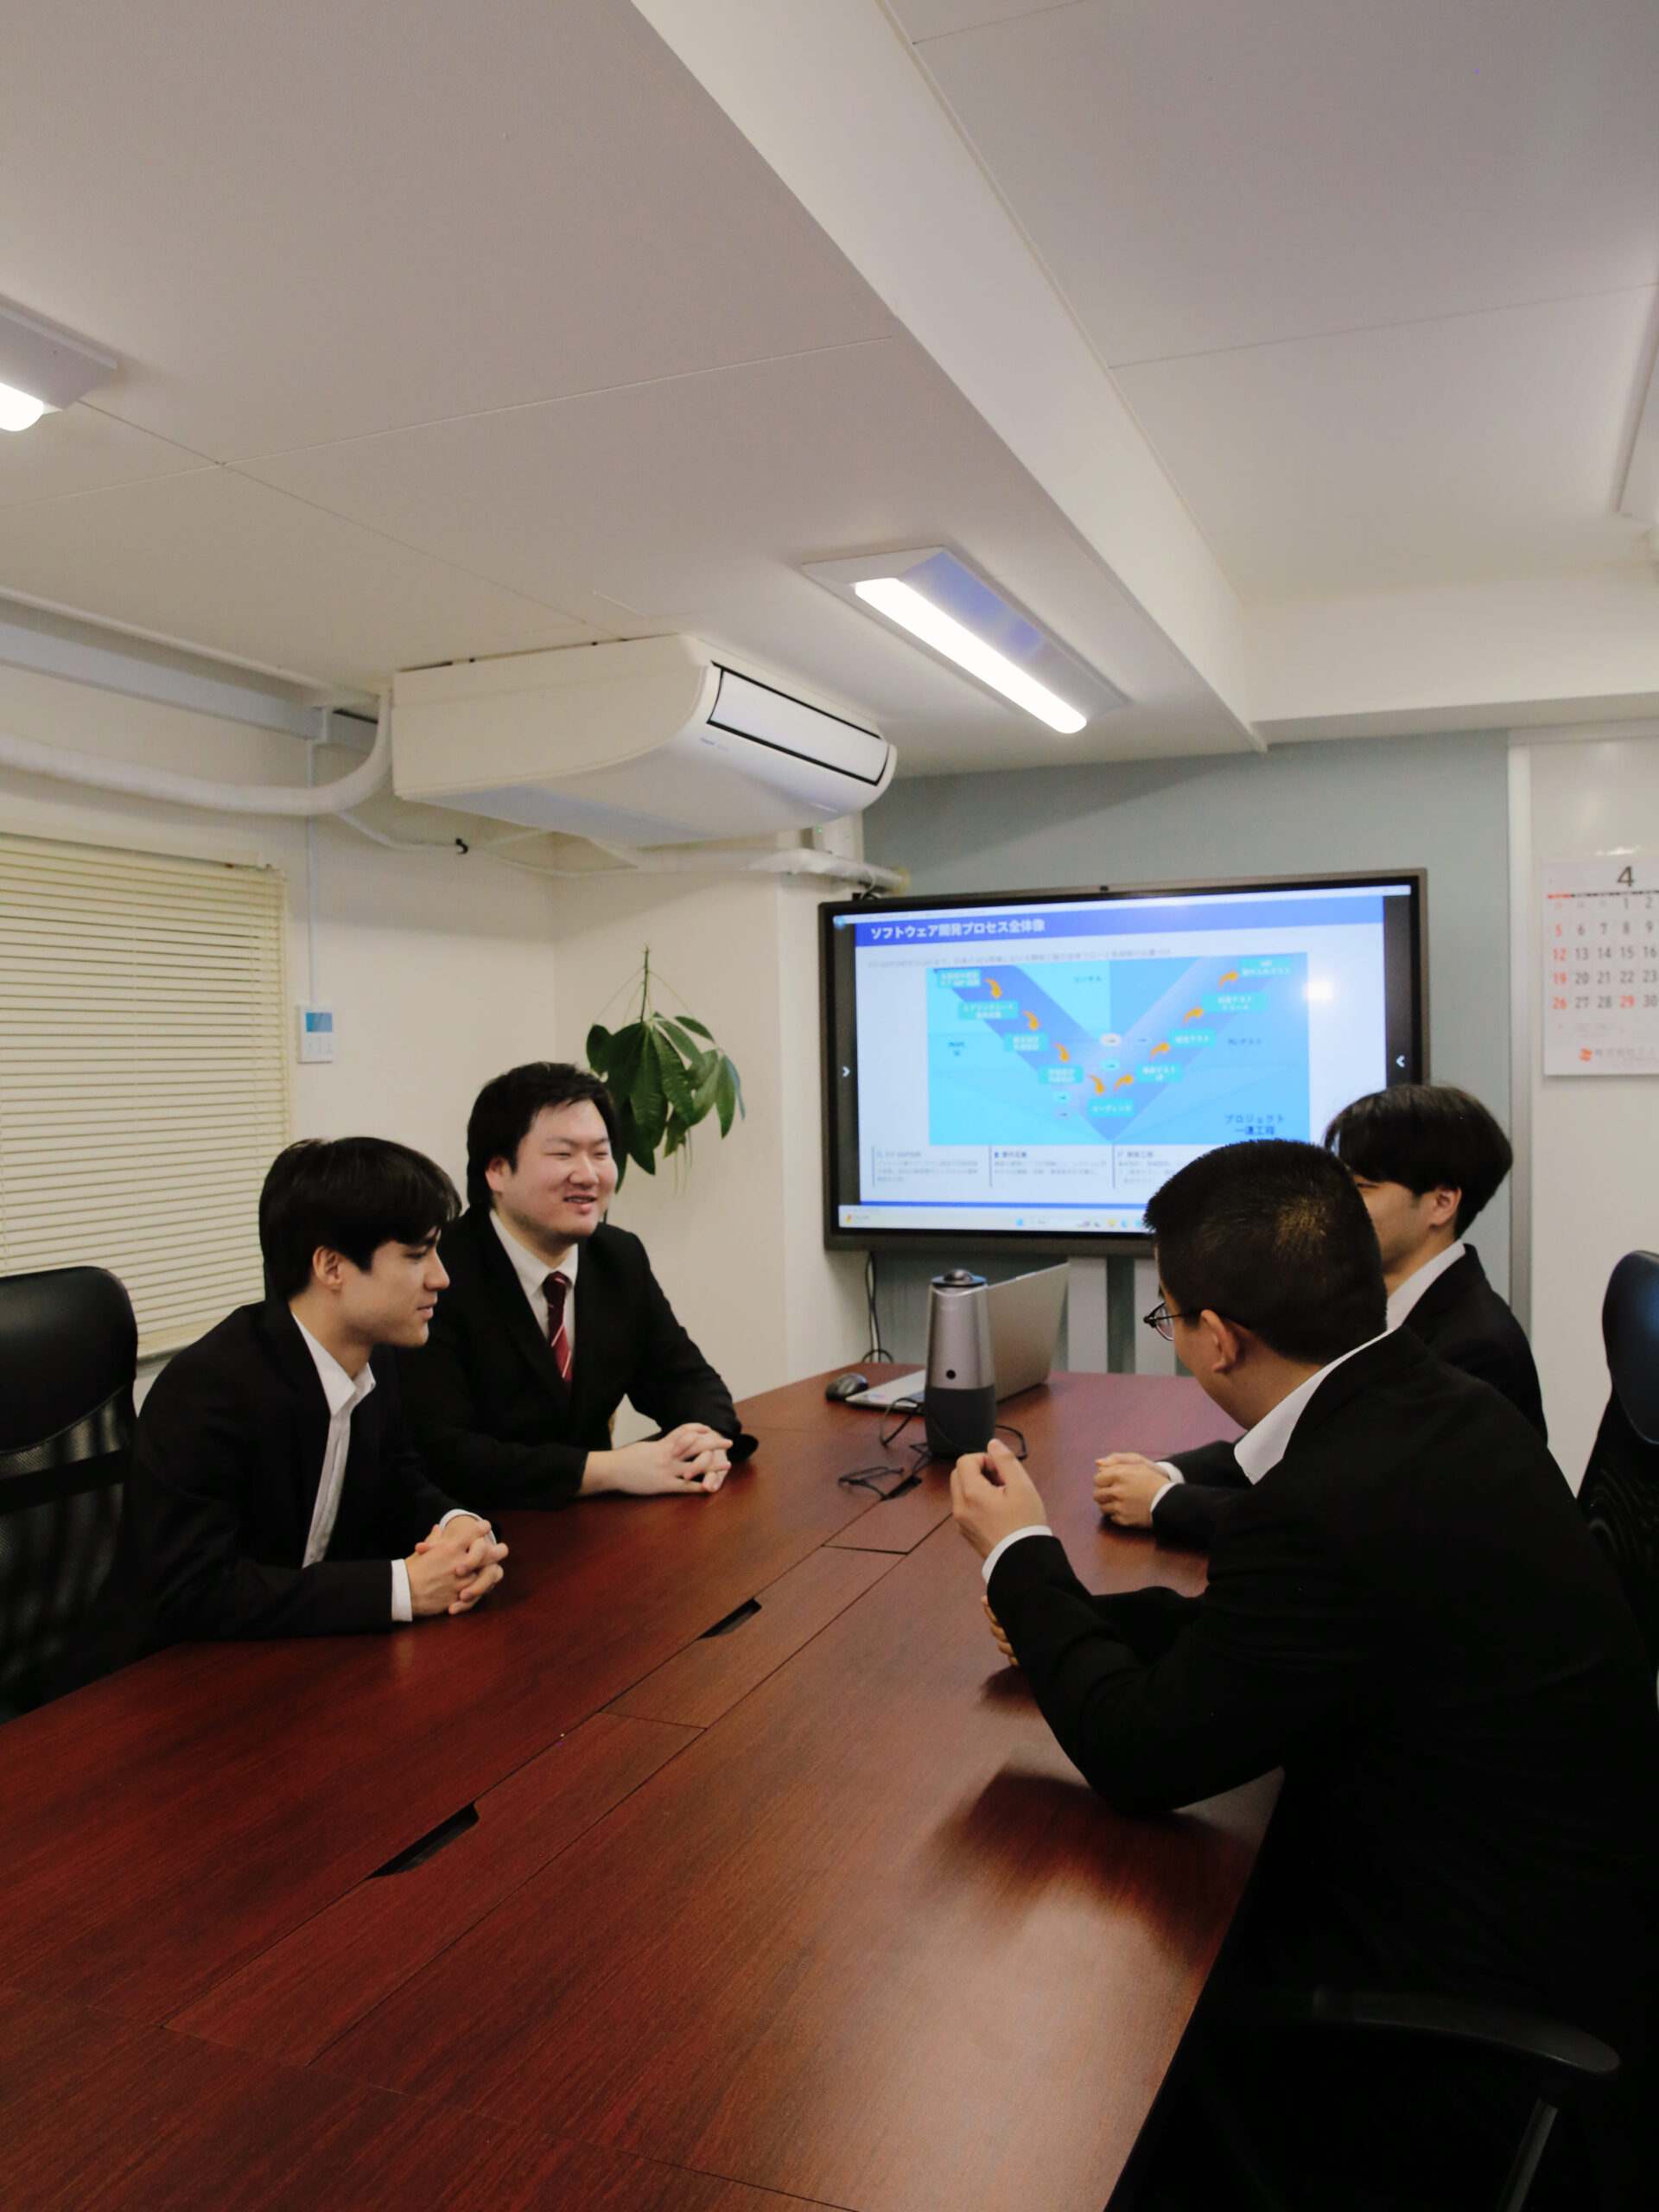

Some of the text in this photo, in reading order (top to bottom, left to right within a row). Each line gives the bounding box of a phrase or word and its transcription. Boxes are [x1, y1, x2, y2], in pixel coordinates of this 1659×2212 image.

[1617, 865, 1636, 887] 4
[1624, 895, 1653, 910] 1 2
[871, 919, 1045, 939] ソフトウェア開発プロセス全体像
[1555, 920, 1654, 937] 5 6 7 8 9
[1553, 945, 1658, 961] 12 13 14 15 16
[1553, 969, 1658, 986] 19 20 21 22 23
[1553, 994, 1658, 1010] 26 27 28 29 30
